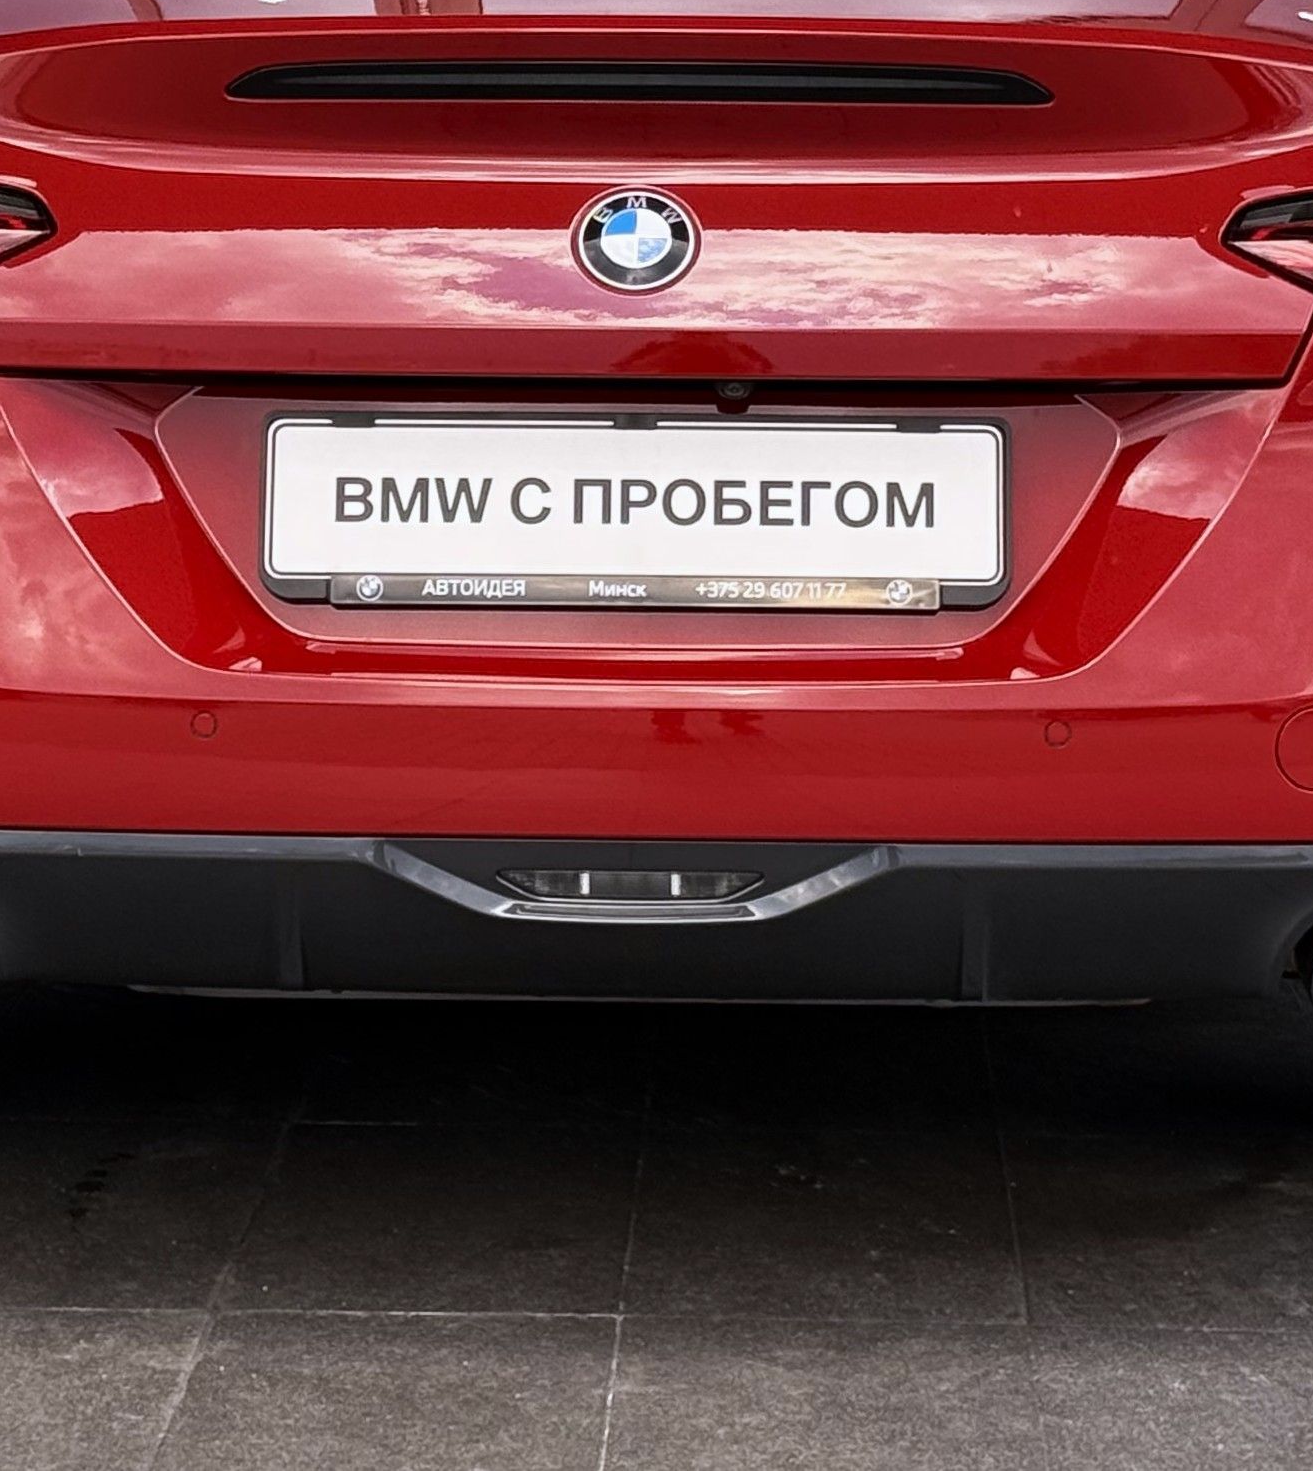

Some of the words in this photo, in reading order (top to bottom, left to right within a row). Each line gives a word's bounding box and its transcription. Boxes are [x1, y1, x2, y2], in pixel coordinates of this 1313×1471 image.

[592, 197, 683, 224] BMW
[335, 477, 492, 523] BMW
[510, 477, 551, 524] С
[573, 479, 934, 528] ПРОБЕГОМ
[421, 579, 526, 599] АВТОИДЕЯ
[588, 580, 648, 598] Минск
[695, 581, 737, 599] +375
[742, 581, 765, 598] 29
[770, 581, 804, 598] 607
[806, 582, 822, 599] 11
[825, 582, 847, 599] 77
